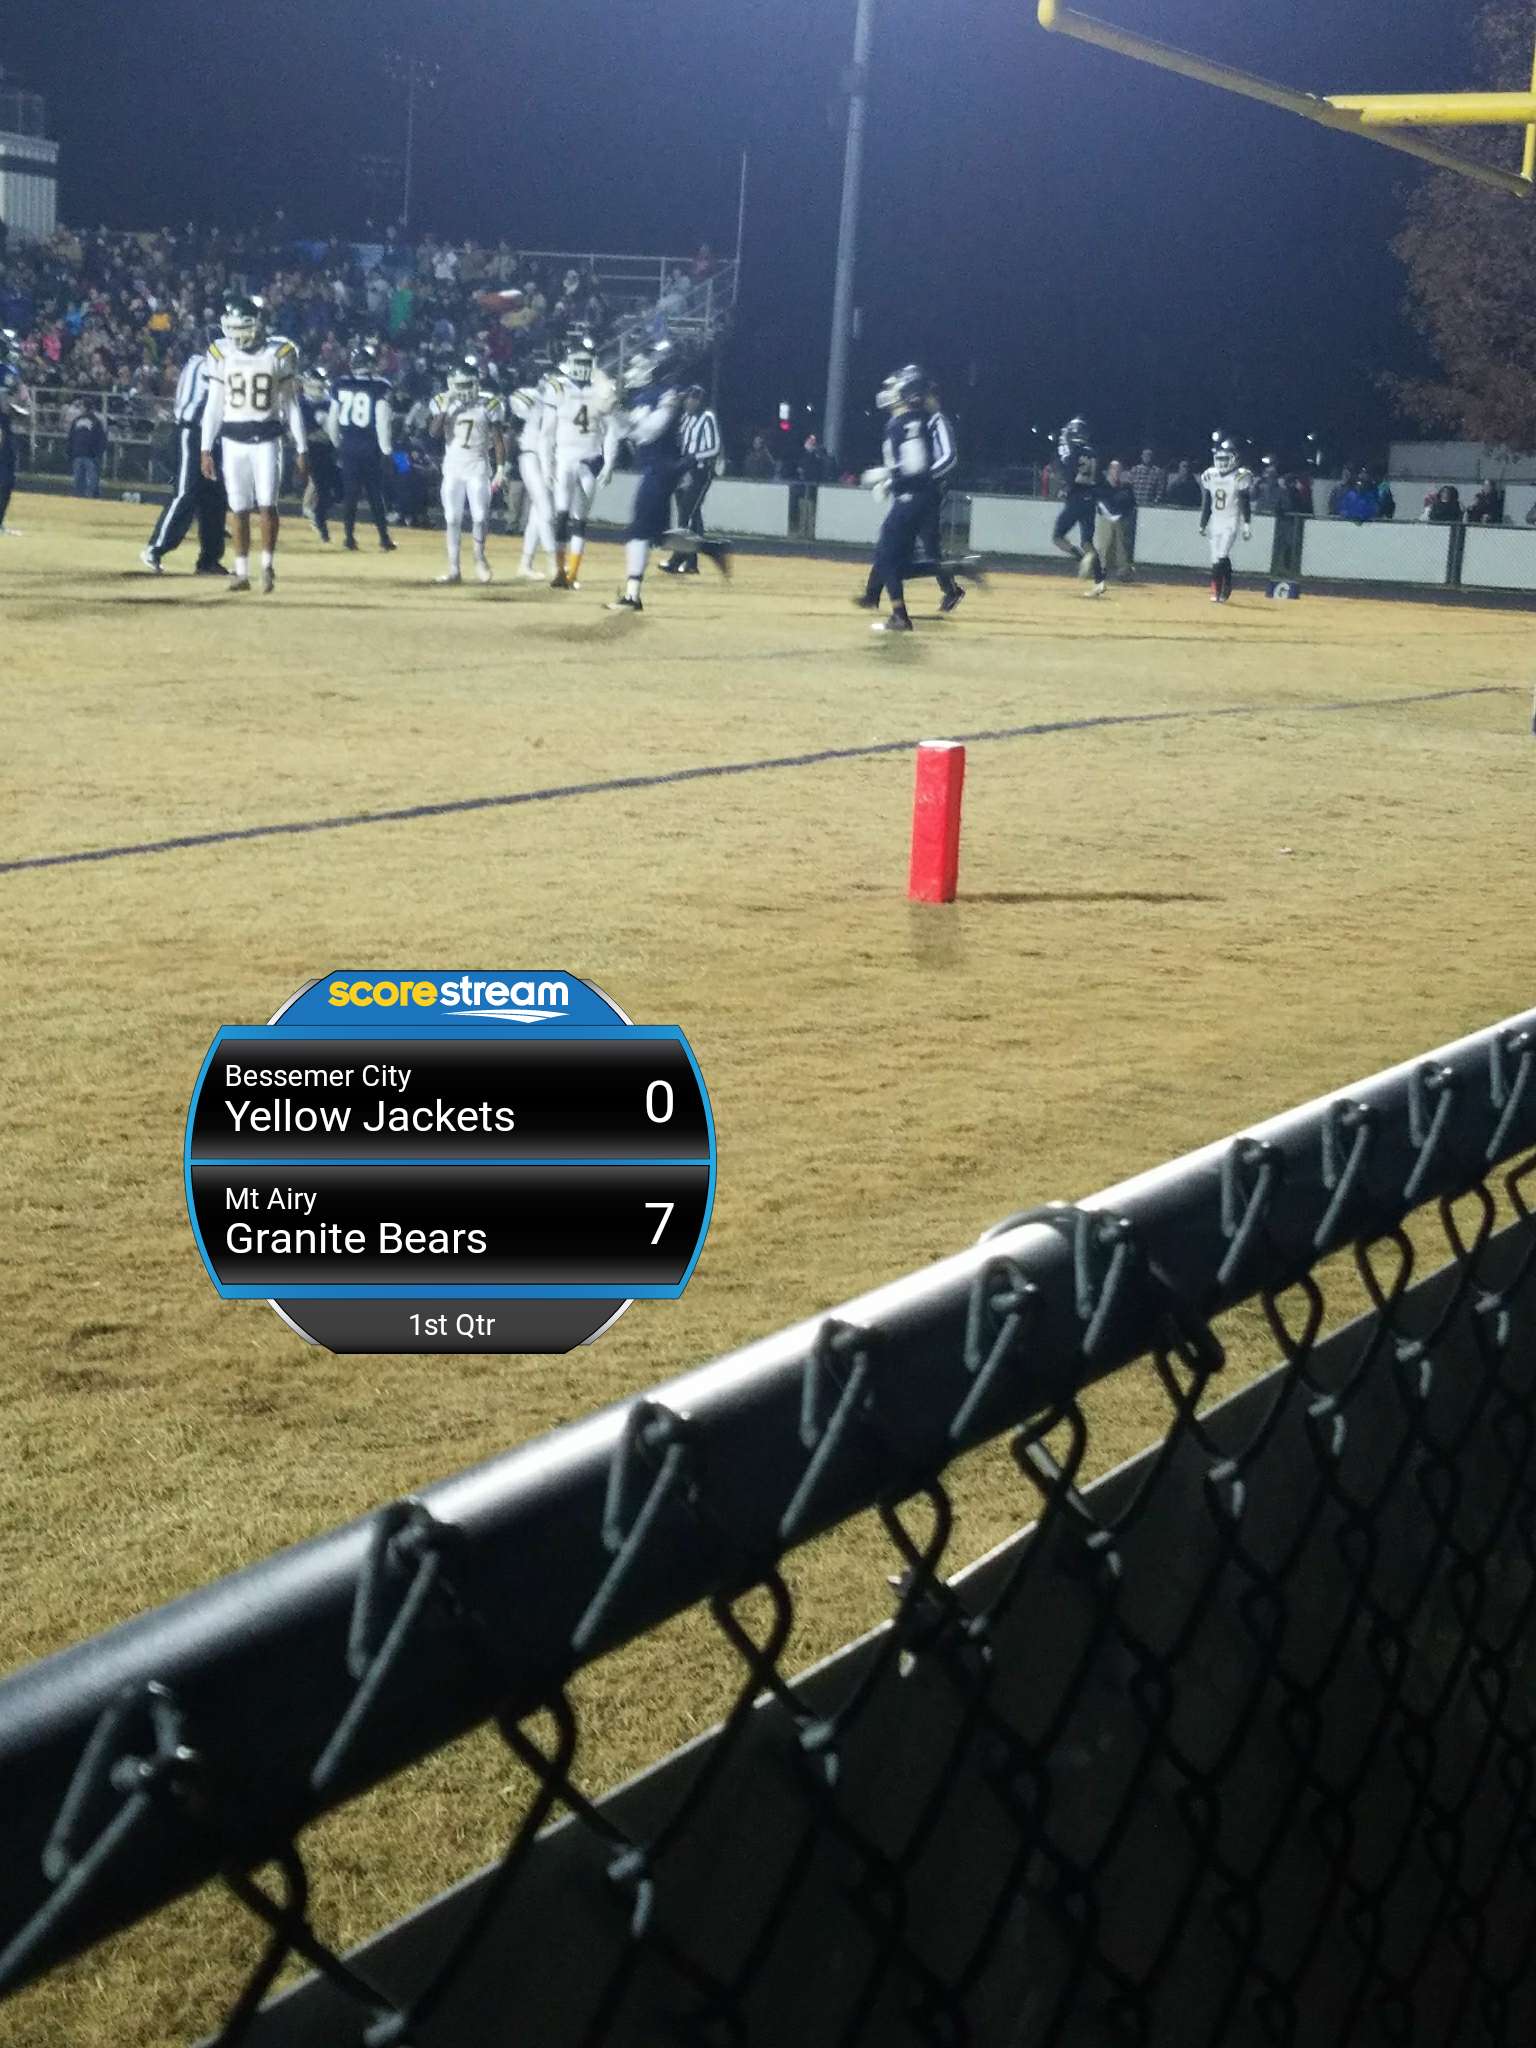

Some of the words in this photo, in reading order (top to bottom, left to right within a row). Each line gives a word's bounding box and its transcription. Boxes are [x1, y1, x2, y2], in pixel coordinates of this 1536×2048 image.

[337, 389, 370, 428] 78
[573, 404, 590, 434] 4
[457, 418, 474, 449] 7
